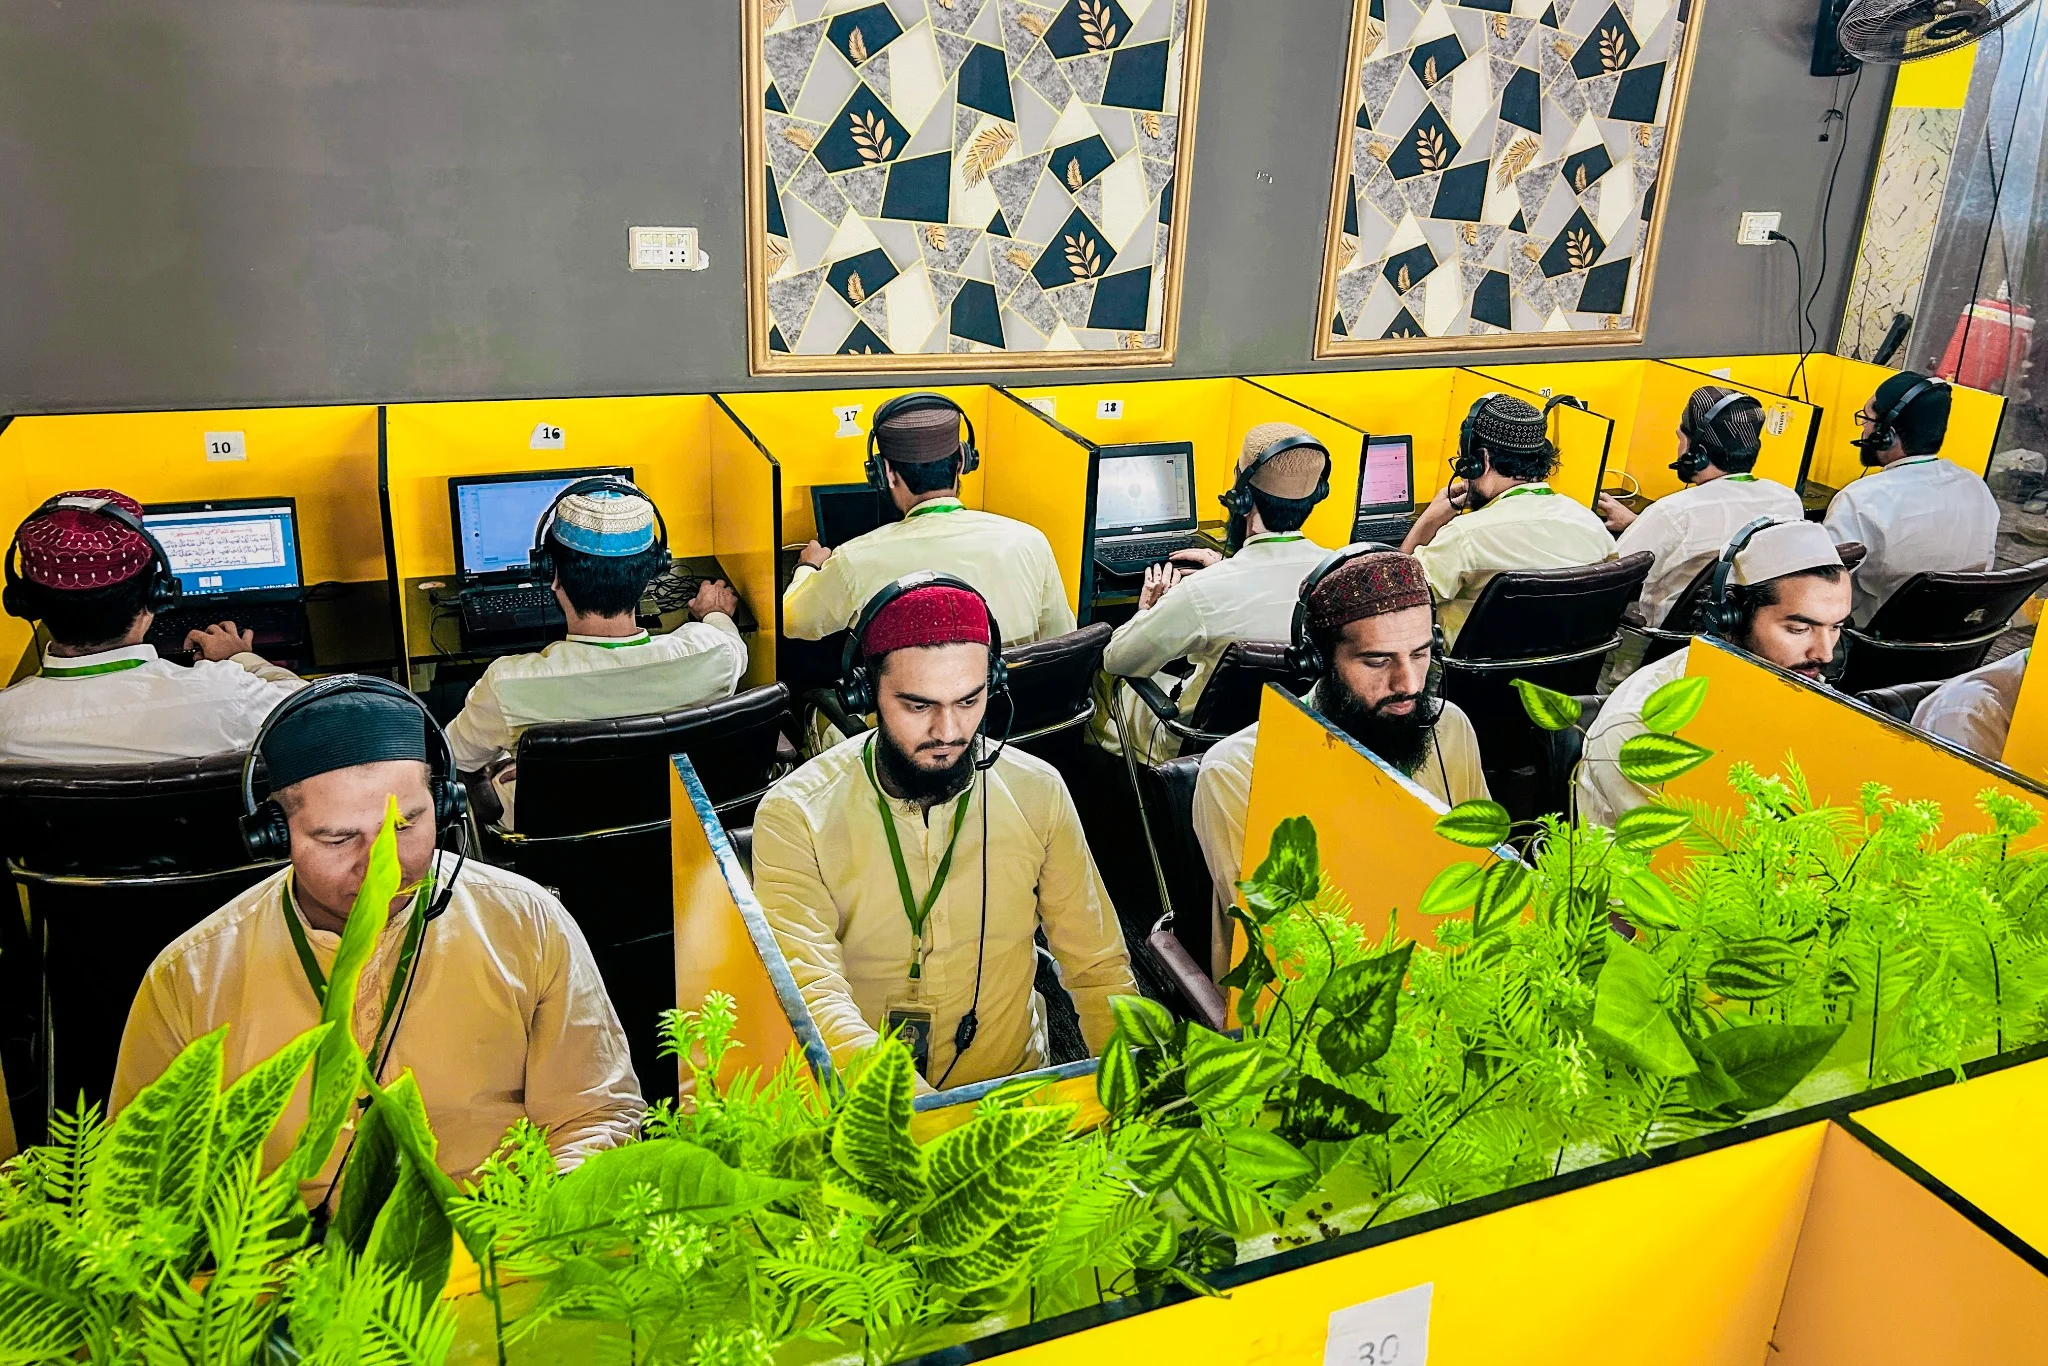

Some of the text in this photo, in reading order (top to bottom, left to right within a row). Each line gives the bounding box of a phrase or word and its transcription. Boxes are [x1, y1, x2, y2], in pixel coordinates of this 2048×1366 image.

[1541, 388, 1551, 397] 20
[1104, 402, 1117, 413] 18
[844, 410, 858, 422] 17
[543, 426, 561, 440] 16
[211, 441, 231, 454] 10
[1358, 1333, 1399, 1366] 30
